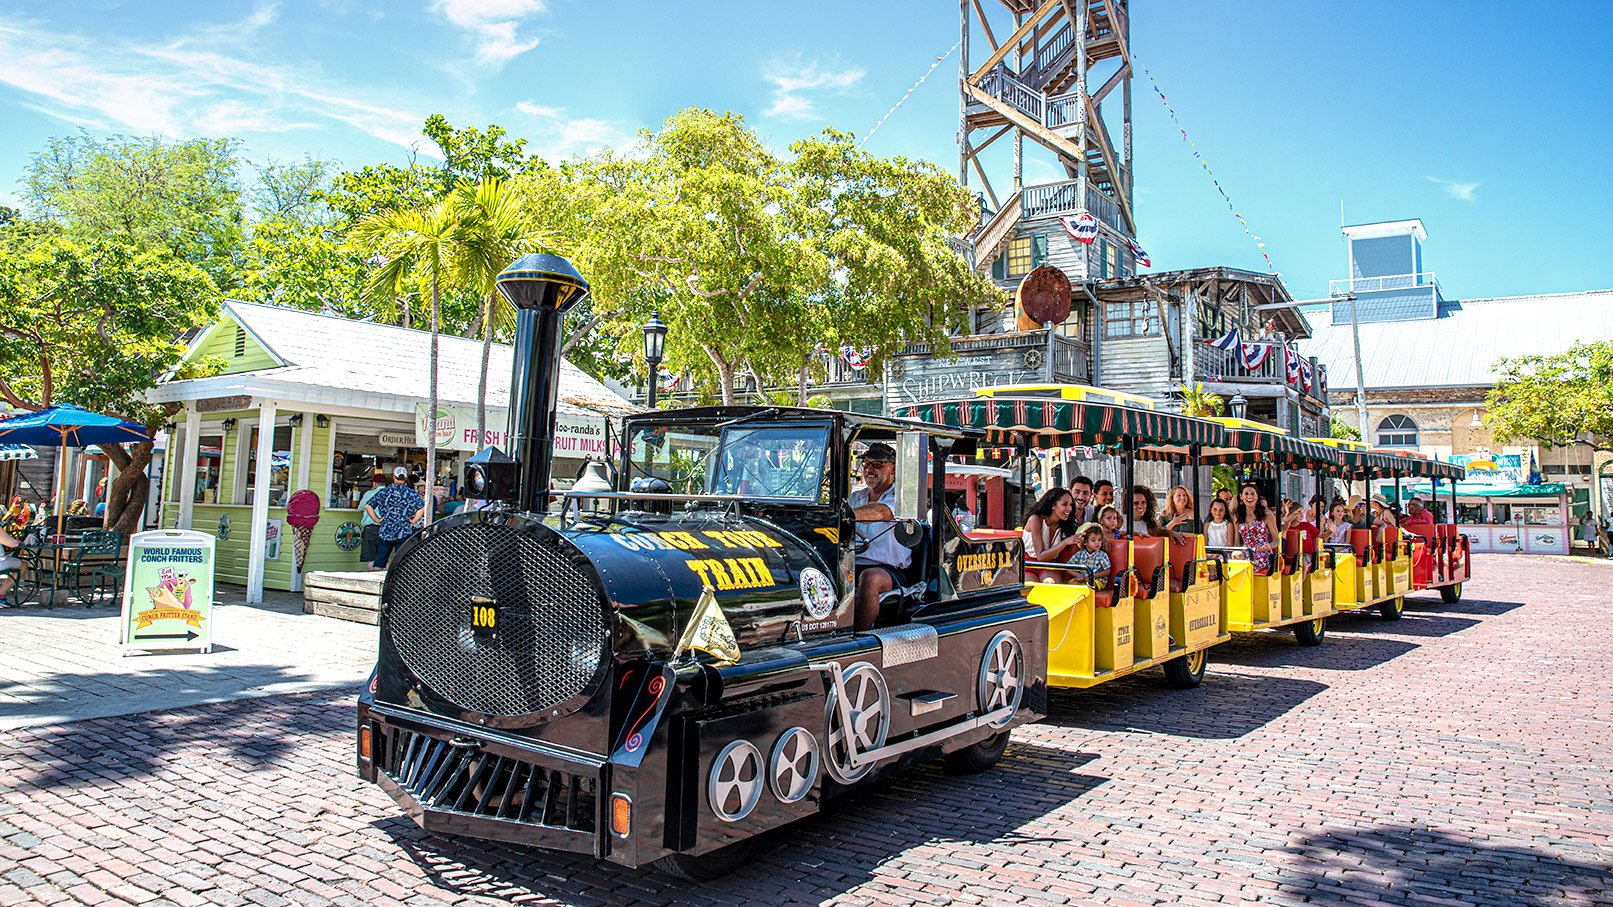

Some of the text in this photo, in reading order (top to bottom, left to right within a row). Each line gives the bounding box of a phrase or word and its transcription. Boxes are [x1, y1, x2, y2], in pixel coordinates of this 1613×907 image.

[964, 356, 992, 366] WEST
[902, 370, 1026, 404] SHIPWRECK
[382, 435, 404, 444] ORDER
[464, 429, 500, 445] FRSH
[554, 436, 578, 451] RUIT
[610, 530, 782, 551] CONCH TOUR
[957, 552, 996, 572] OVERSEAS
[685, 557, 776, 591] TRAIN
[142, 612, 158, 621] CONCH
[472, 606, 495, 627] 108
[1117, 635, 1130, 646] ISLAND
[1118, 625, 1130, 636] STOCK
